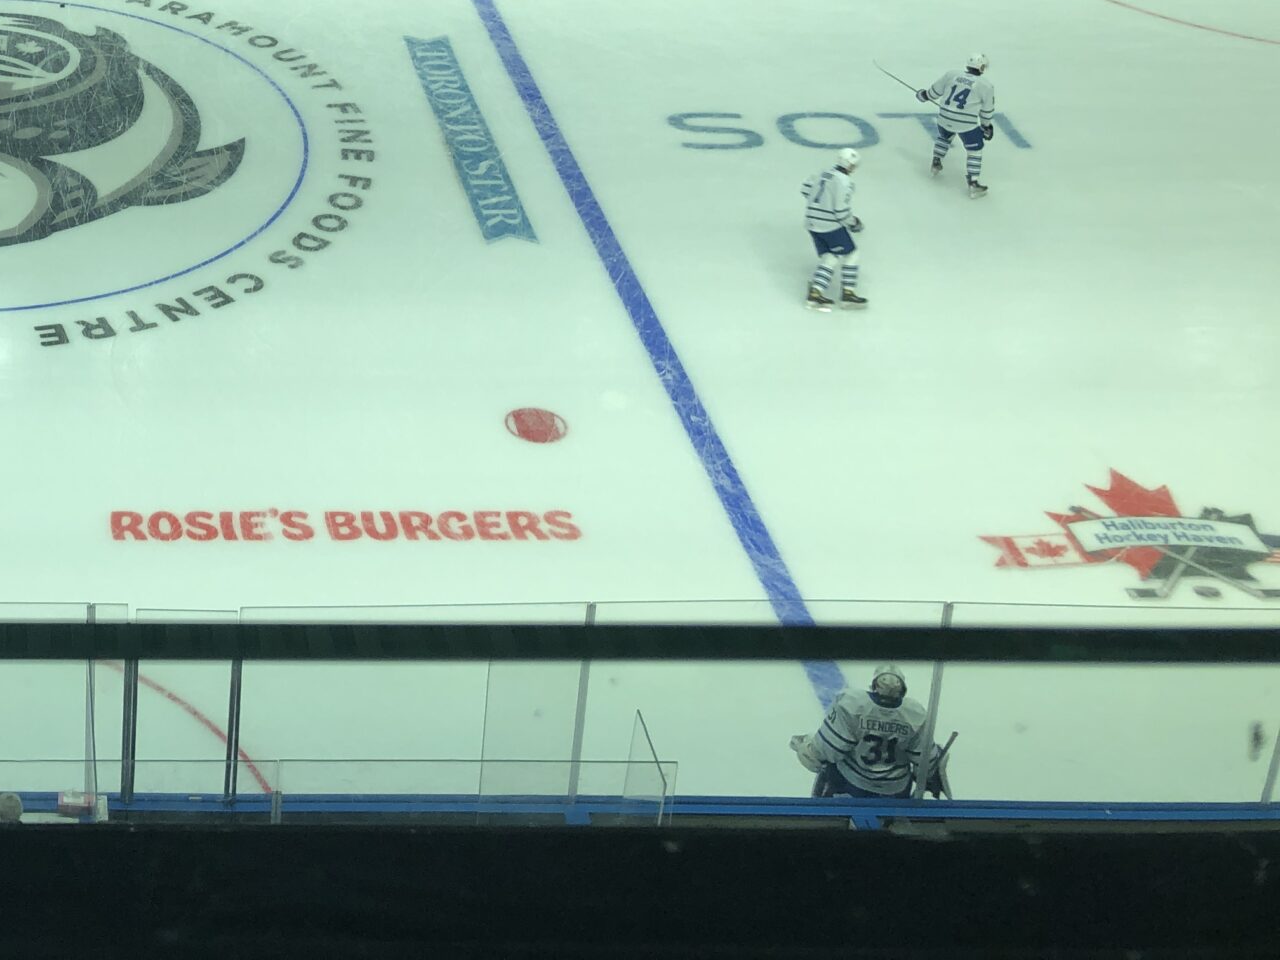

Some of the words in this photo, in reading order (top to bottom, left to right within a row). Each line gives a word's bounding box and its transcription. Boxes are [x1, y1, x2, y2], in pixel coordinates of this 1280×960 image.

[945, 84, 971, 110] 14
[327, 98, 377, 164] FINE
[415, 48, 492, 152] TORONTO
[462, 159, 522, 227] STAR
[268, 172, 374, 272] FOODS
[32, 271, 268, 349] CENTRE
[109, 507, 316, 542] ROSIE'S
[324, 510, 584, 542] BURGERS
[1094, 531, 1170, 545] Hockey
[1173, 531, 1245, 546] Haven
[1100, 518, 1215, 532] Haliburton
[859, 718, 911, 736] LEENDERS
[860, 733, 899, 766] 31
